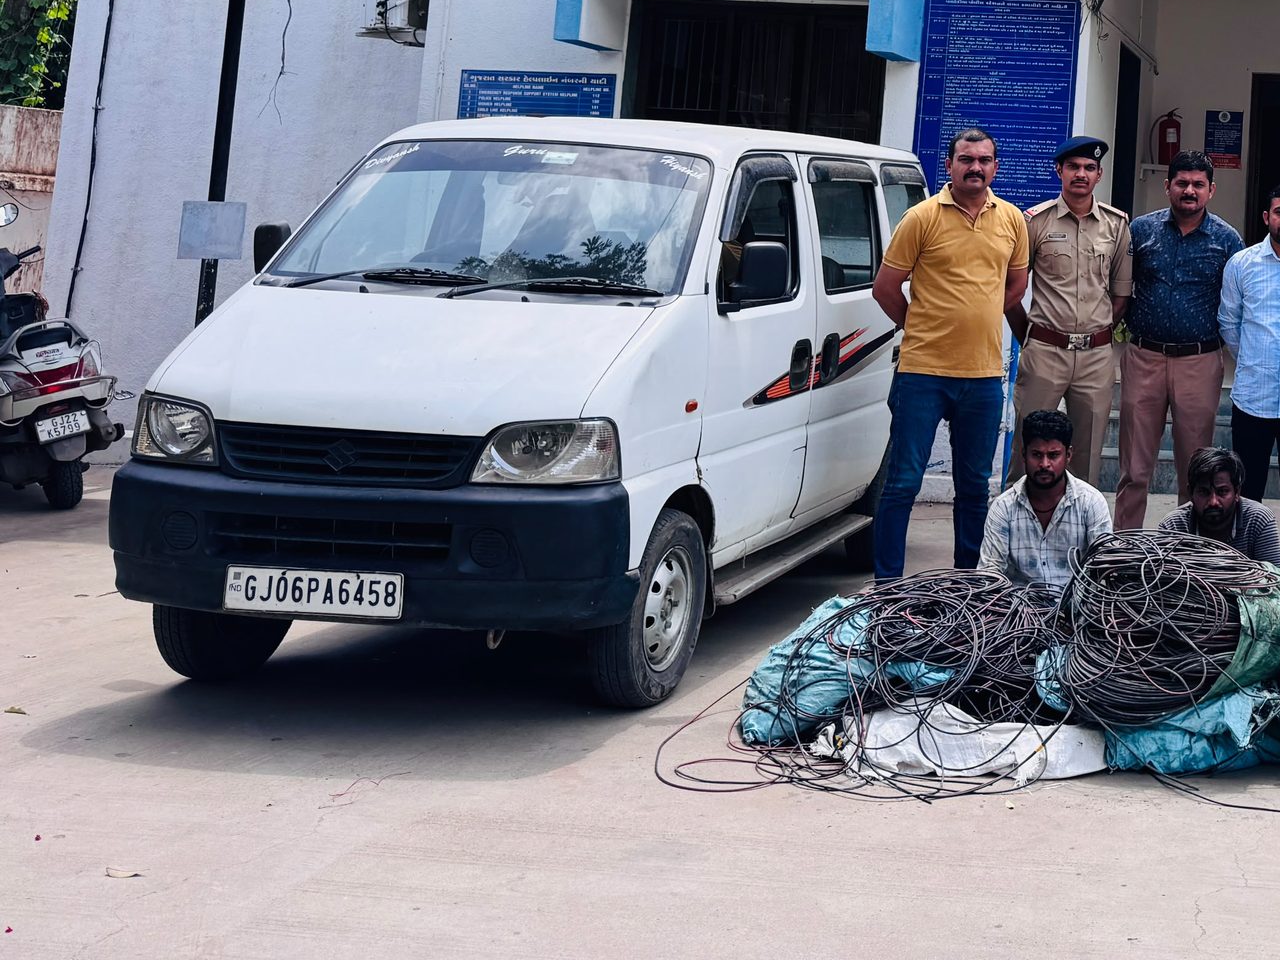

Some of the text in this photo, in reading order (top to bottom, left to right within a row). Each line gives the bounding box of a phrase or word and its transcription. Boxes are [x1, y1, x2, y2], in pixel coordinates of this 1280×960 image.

[503, 145, 547, 156] Guru
[51, 413, 79, 427] GJ22
[47, 423, 81, 438] K5799
[228, 575, 397, 607] IND GJ06PA6458
